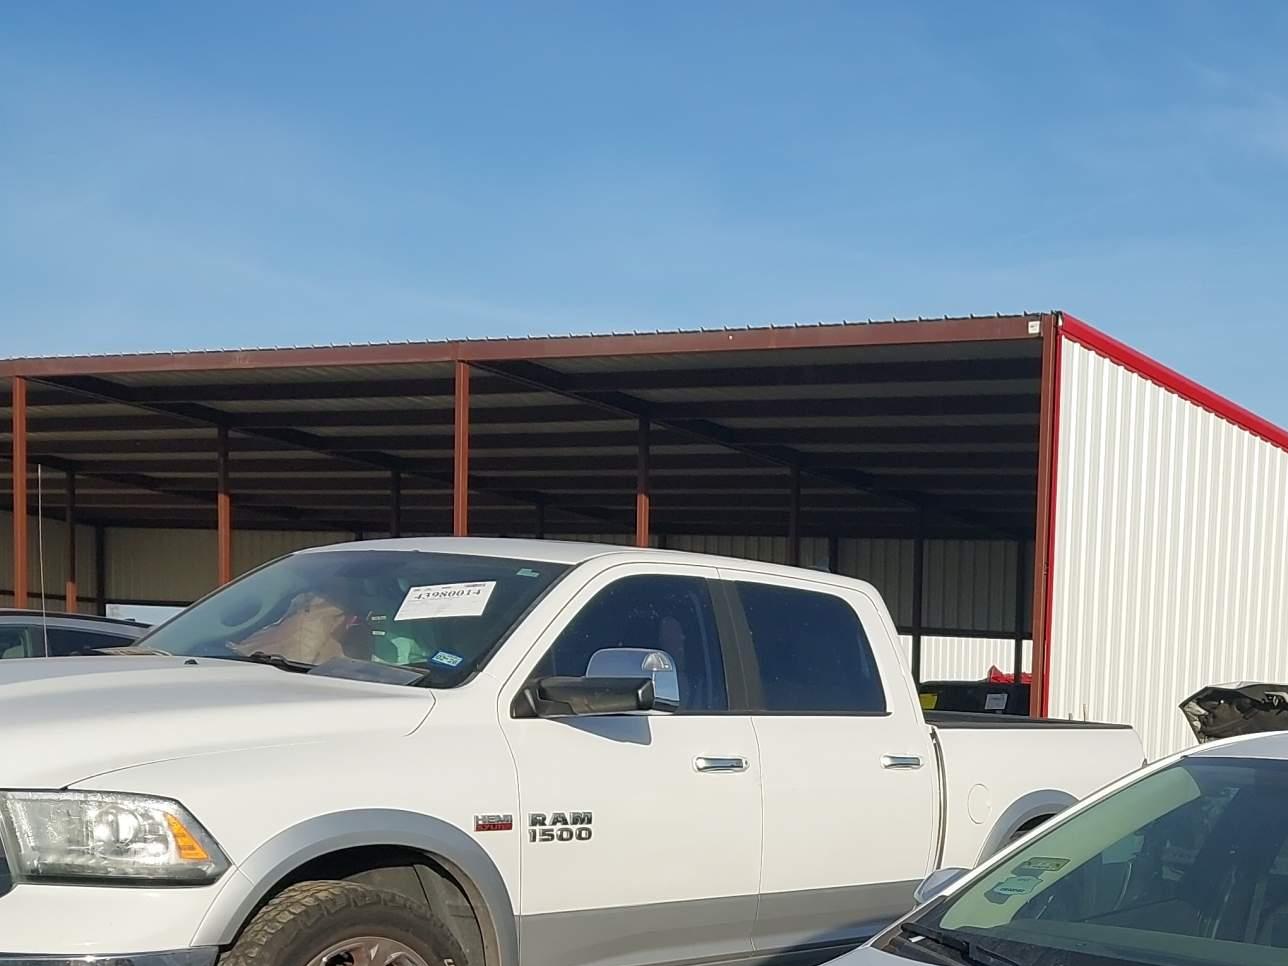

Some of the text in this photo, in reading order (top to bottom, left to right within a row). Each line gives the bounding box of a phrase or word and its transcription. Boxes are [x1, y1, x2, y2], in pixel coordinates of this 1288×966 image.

[414, 589, 481, 600] 43980014
[529, 812, 592, 826] RAM
[529, 827, 592, 843] 1500
